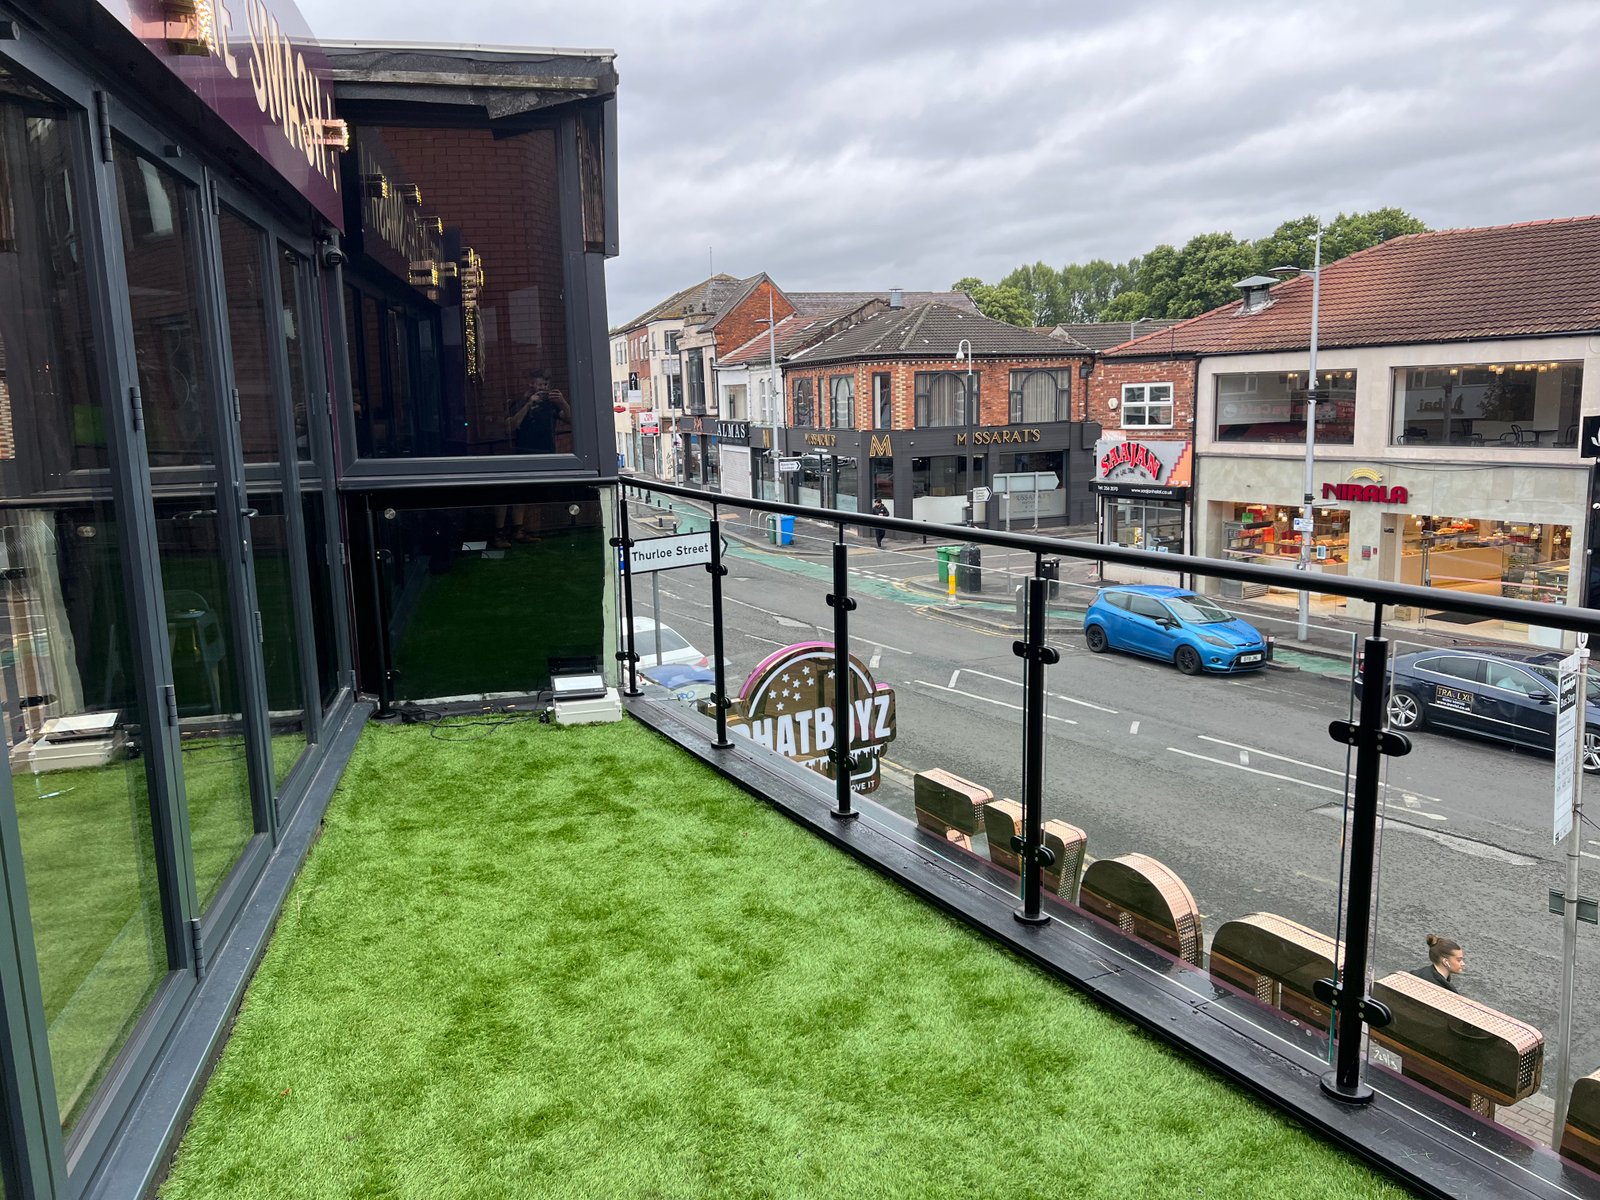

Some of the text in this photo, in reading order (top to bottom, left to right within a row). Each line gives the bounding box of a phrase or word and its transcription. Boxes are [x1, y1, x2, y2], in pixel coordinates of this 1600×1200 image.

[717, 423, 746, 438] ALMAS
[869, 434, 893, 457] M
[1101, 442, 1161, 479] SAAJAN
[1322, 483, 1408, 504] NIRALA
[632, 543, 709, 562] Thurloe Street
[731, 694, 890, 757] HATBYZ
[851, 780, 875, 791] OVE IT
